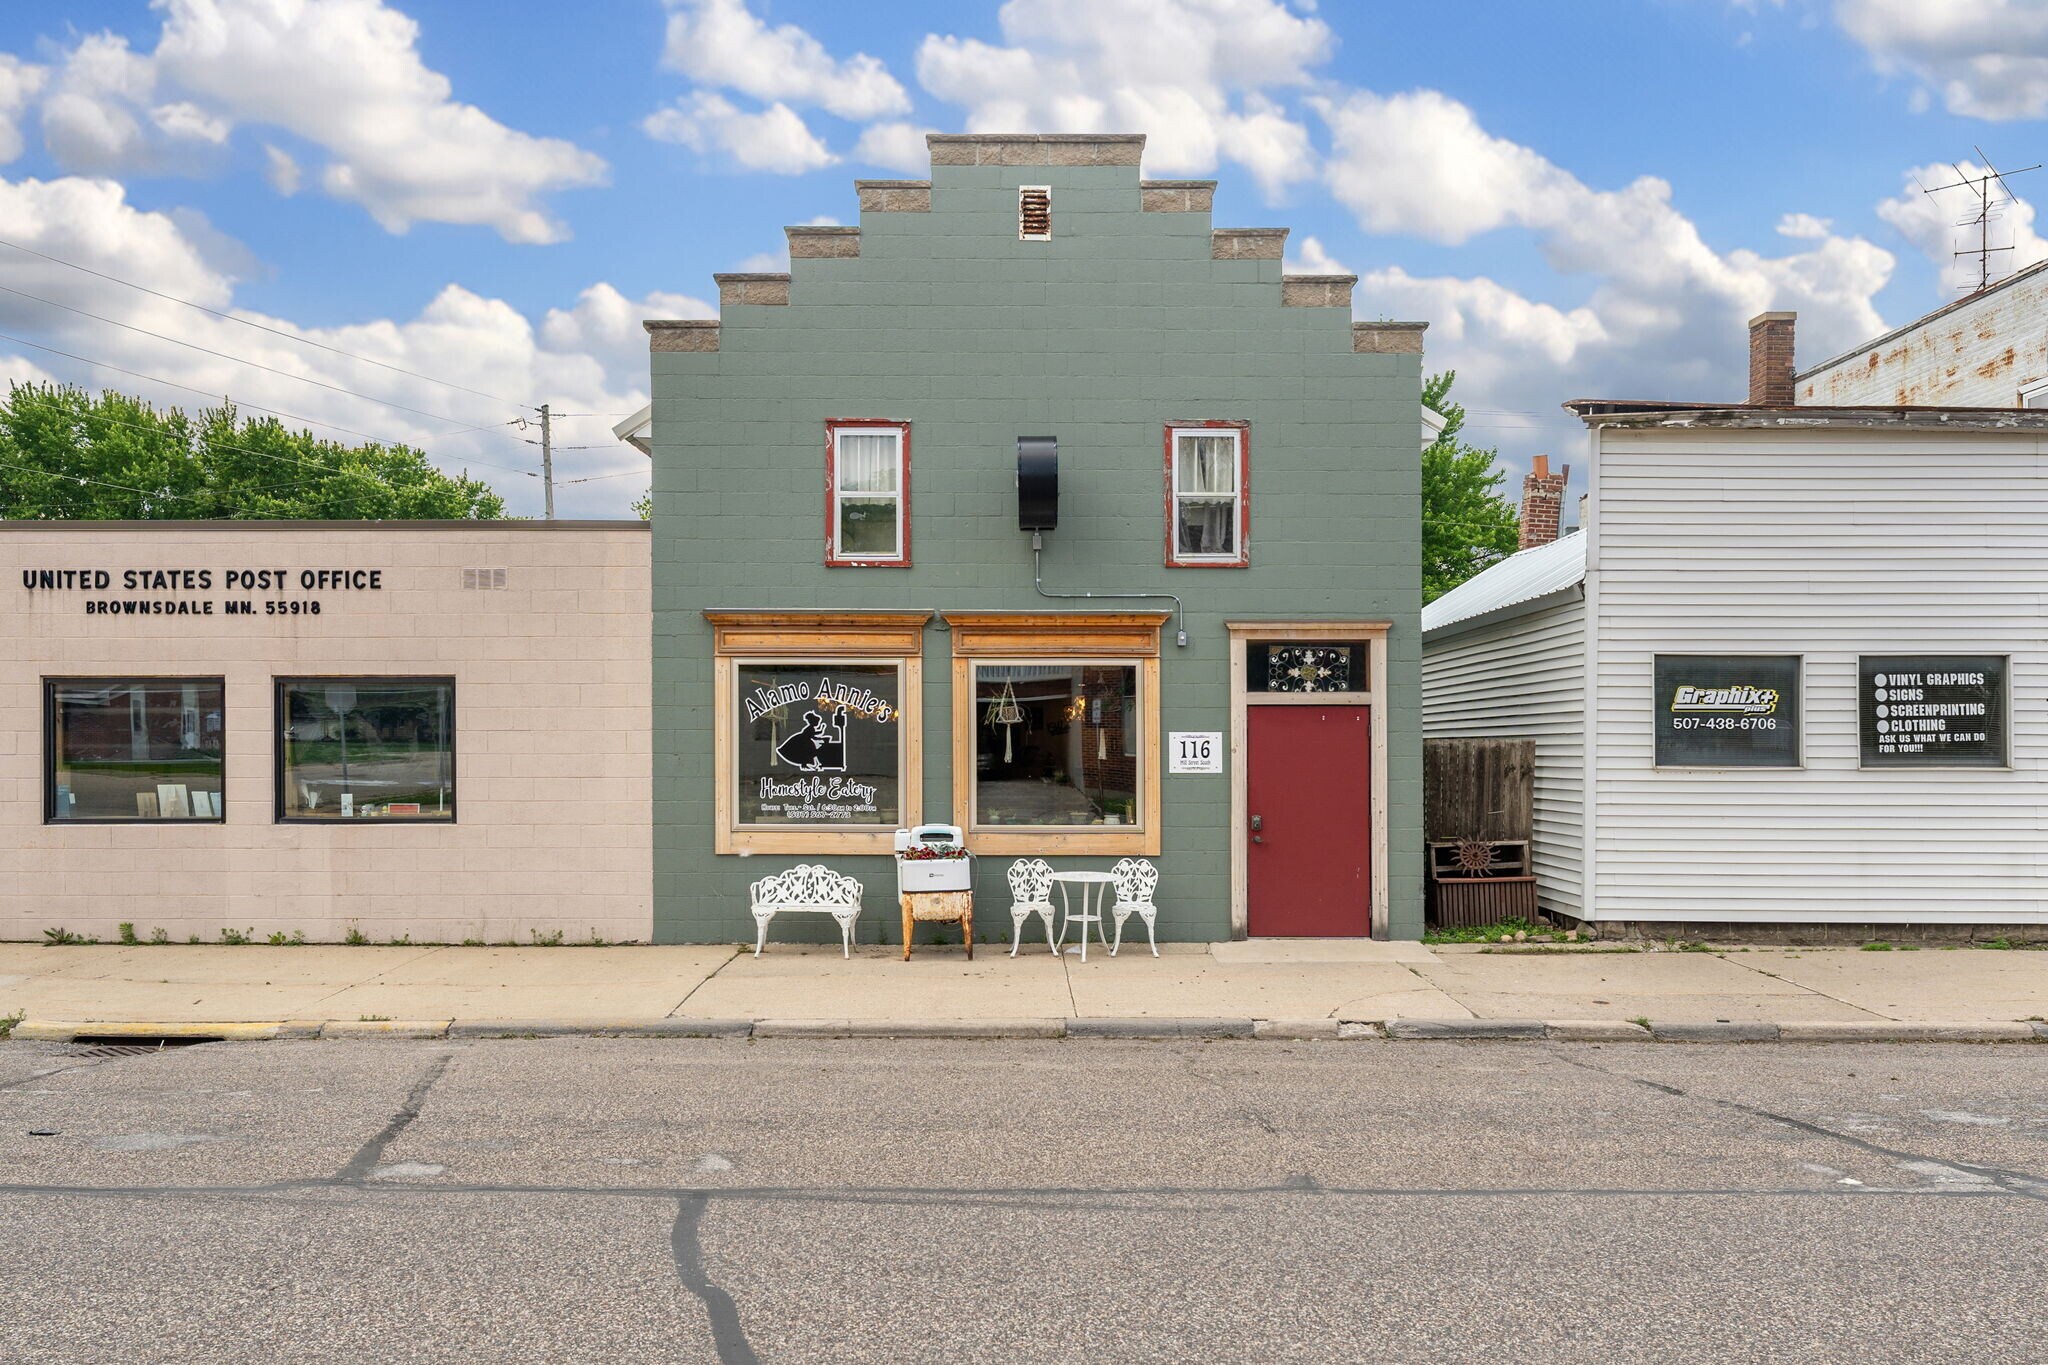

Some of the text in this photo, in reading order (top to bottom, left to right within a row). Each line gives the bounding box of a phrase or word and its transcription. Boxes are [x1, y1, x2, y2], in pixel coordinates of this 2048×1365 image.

[23, 570, 382, 589] UNITED STATES POST OFFICE
[86, 600, 321, 615] BROWNSDALE MN. 55918
[1888, 673, 1984, 686] VINYL GRAPHICS
[745, 677, 892, 723] Alamo Annie's
[1889, 688, 1924, 701] SIGNS
[1743, 704, 1768, 714] plus
[1890, 703, 1985, 717] SCREENPRINTING
[1673, 717, 1777, 730] 507-438-6706
[1891, 719, 1946, 731] CLOTHING
[1879, 732, 1985, 743] ASK US WHAT WE CAN DO
[1180, 740, 1210, 759] 116
[1879, 744, 1924, 753] FOR YOU!!!
[760, 776, 878, 805] Homestyle Eatery
